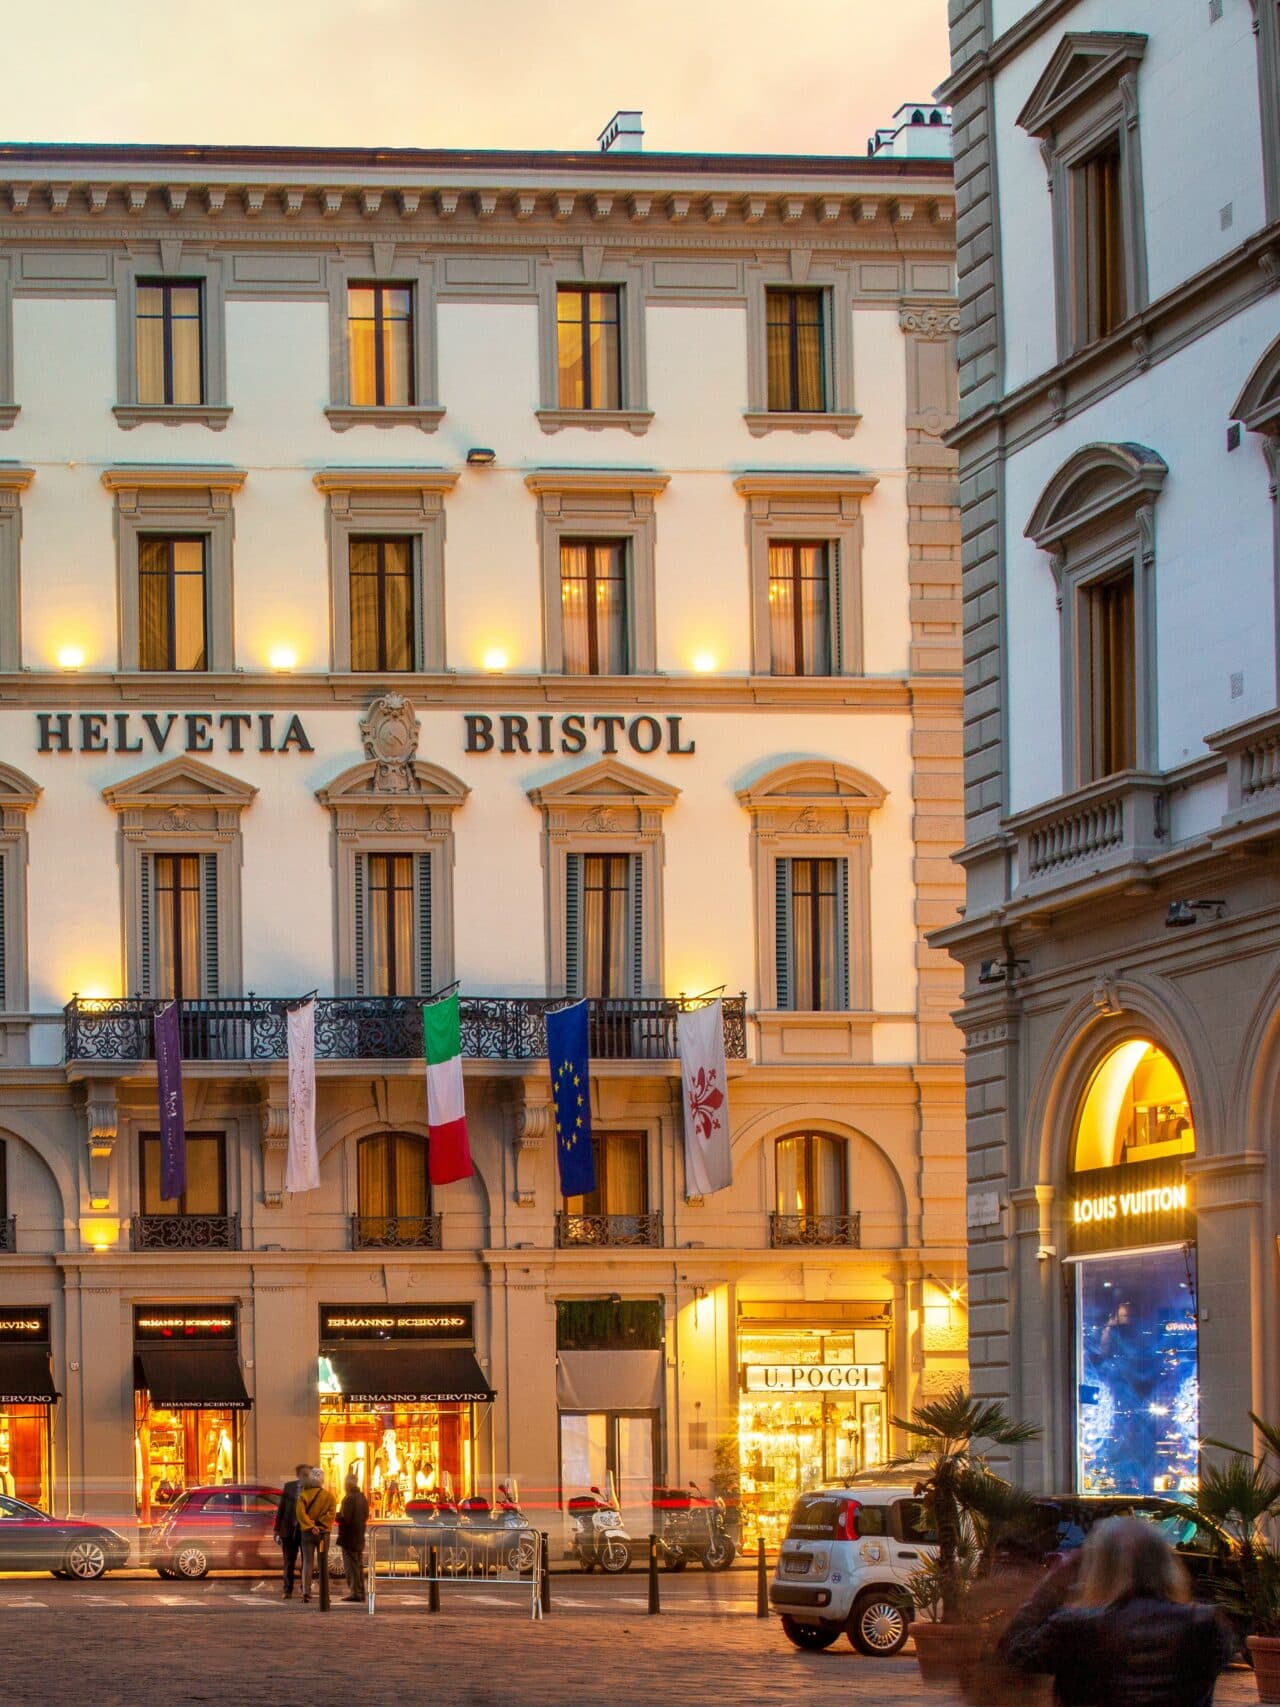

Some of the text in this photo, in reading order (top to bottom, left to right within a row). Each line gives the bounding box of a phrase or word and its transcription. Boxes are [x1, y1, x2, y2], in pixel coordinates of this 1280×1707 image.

[36, 713, 695, 755] HELVETIA BRISTOL
[1073, 1183, 1187, 1224] LOUIS VUITTON
[327, 1317, 465, 1327] ERMANNO SCERVINO
[763, 1367, 870, 1388] U. POGGI
[349, 1393, 488, 1402] ERMANNO SCERVINO
